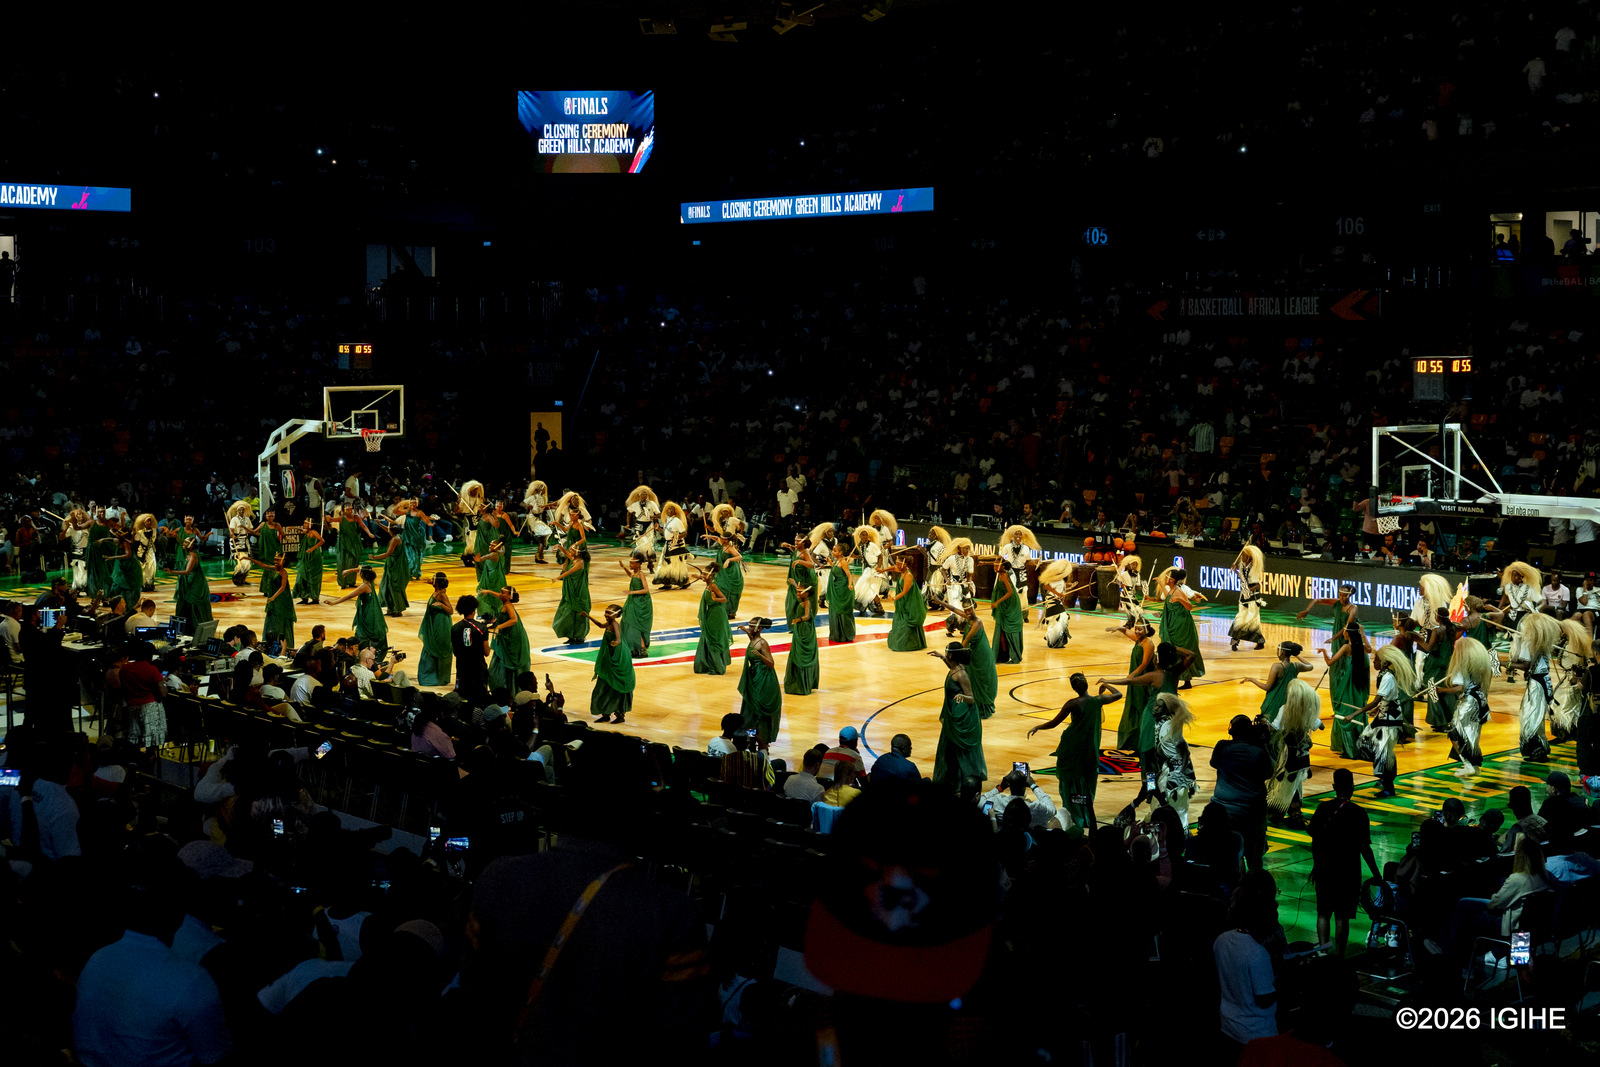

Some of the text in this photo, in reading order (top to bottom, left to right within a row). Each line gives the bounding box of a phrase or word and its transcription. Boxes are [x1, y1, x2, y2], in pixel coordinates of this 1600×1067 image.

[572, 97, 608, 115] FINALS
[543, 123, 629, 139] CLOSING CEREMONY
[538, 138, 635, 154] GREEN HILLS ACADEMY
[0, 185, 58, 205] ACADEMY
[691, 193, 882, 219] FINALS CLOSING CEREMONY GREEN HILLS ACADEMY
[1335, 217, 1365, 235] 106
[1084, 226, 1108, 245] 105
[244, 237, 276, 254] 103
[1187, 295, 1320, 316] BASKETBALL AFRICA LEAGUE
[1440, 504, 1485, 514] VISIT RWANDA
[1304, 576, 1339, 600] GREEN
[500, 811, 515, 824] STEP
